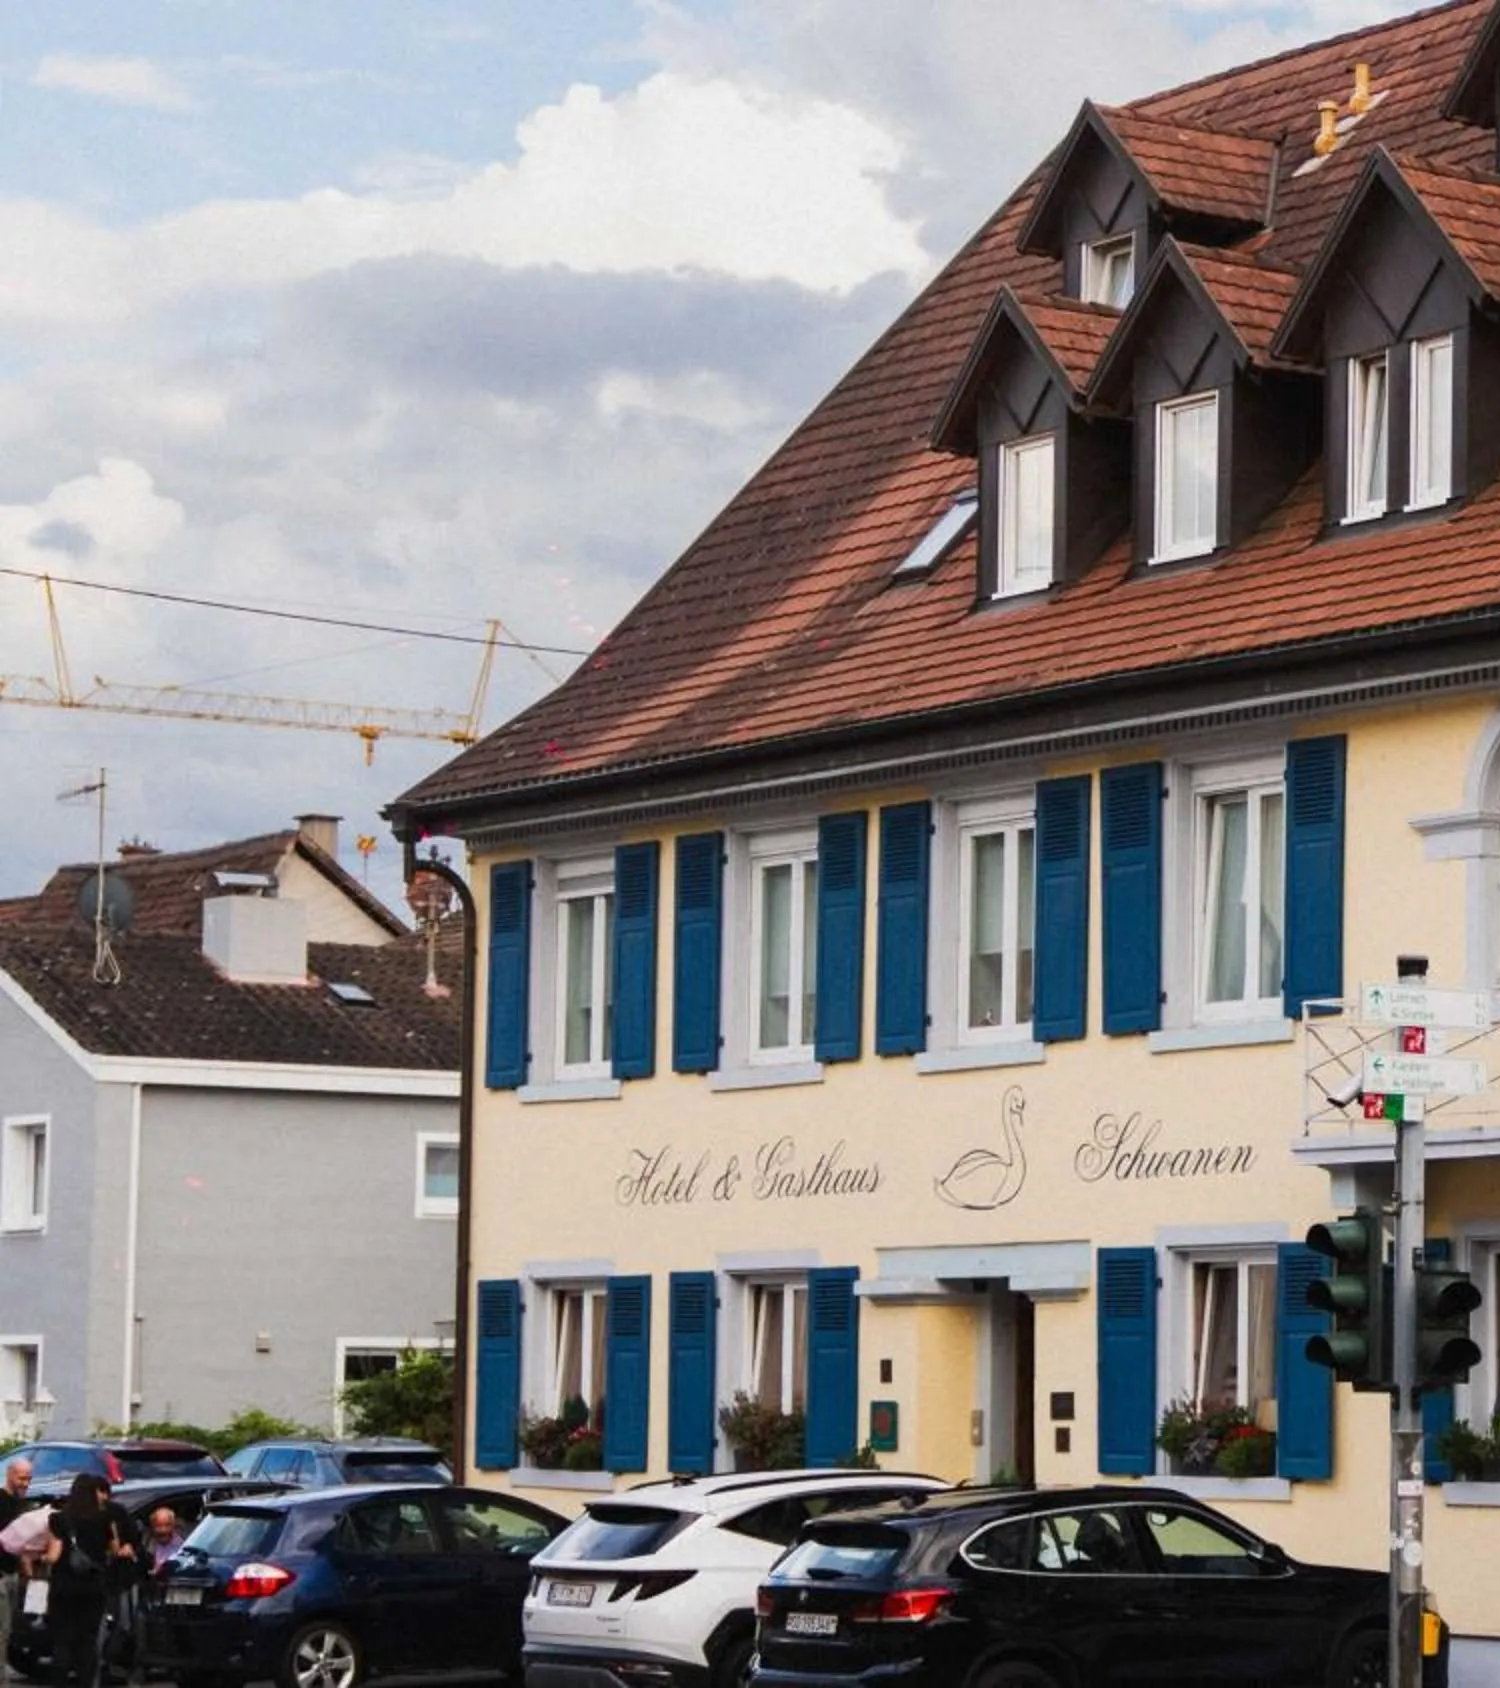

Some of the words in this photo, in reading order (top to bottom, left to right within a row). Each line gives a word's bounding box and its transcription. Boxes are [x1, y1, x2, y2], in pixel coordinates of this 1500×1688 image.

[614, 1143, 710, 1206] Hotel
[712, 1154, 742, 1202] &
[752, 1134, 882, 1201] Gasthaus
[1073, 1110, 1258, 1184] Schwanen
